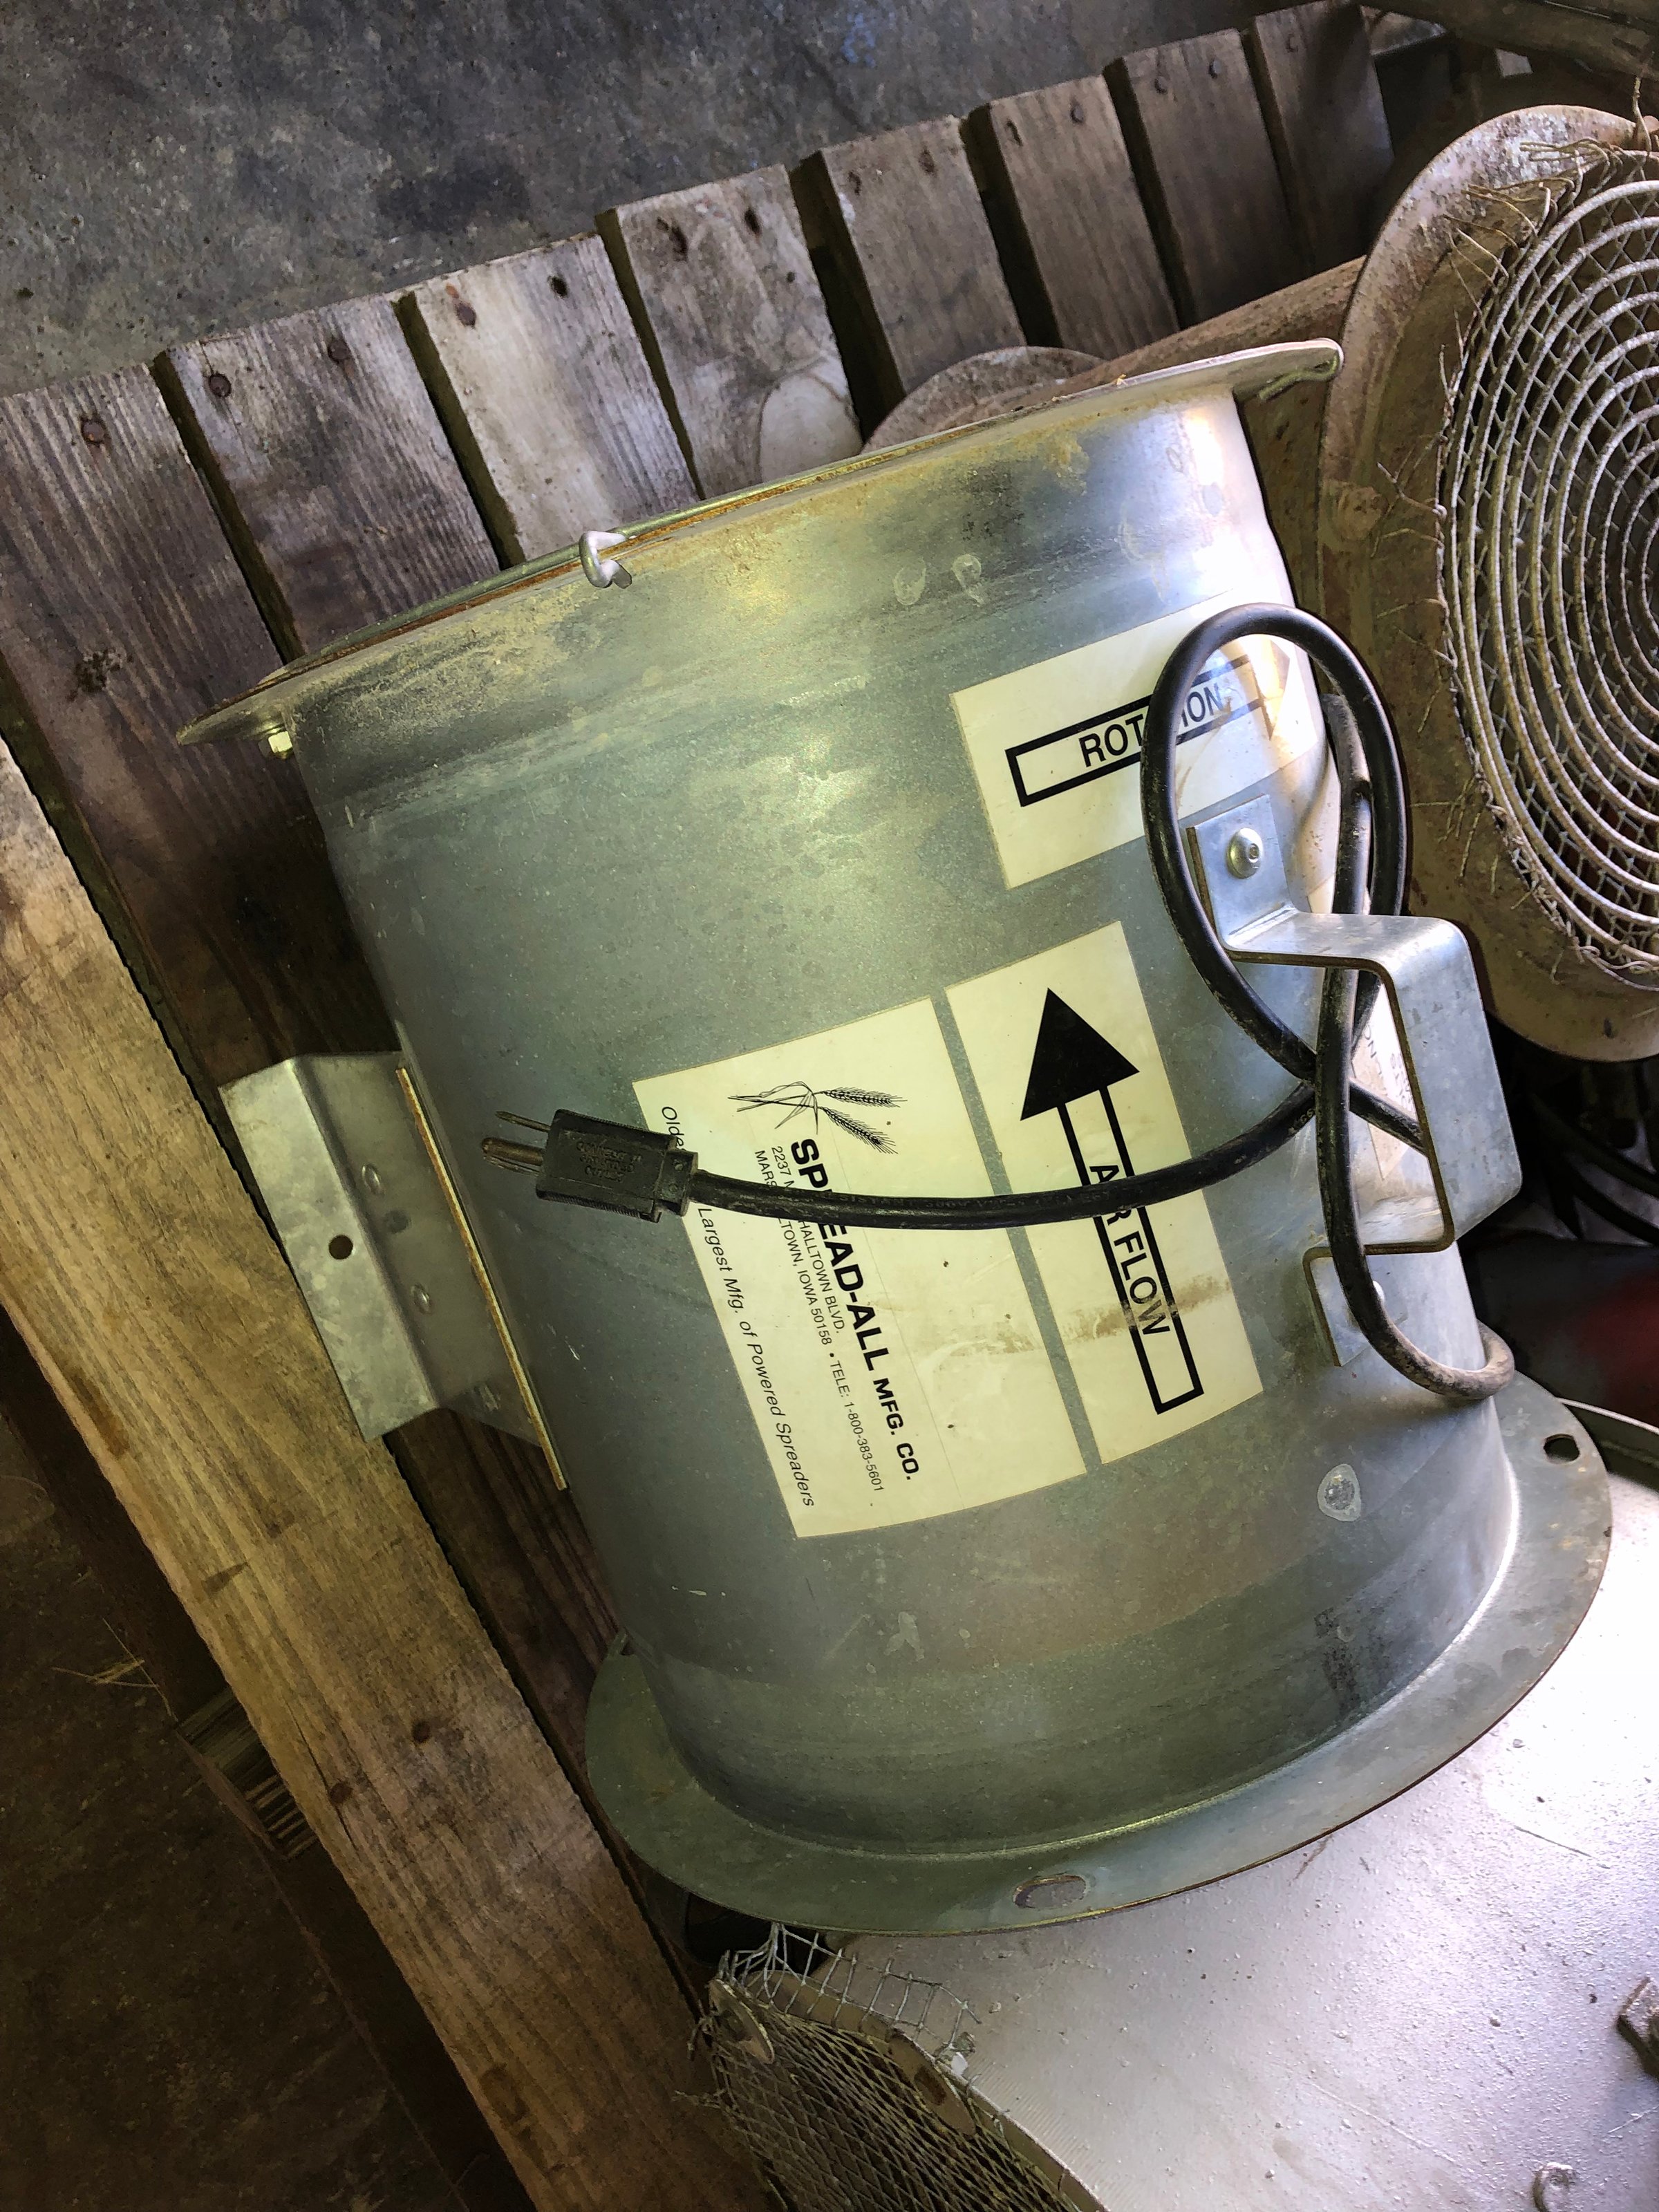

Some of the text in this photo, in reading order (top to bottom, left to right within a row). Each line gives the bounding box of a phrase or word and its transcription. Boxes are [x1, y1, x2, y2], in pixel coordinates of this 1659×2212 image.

[1078, 682, 1224, 768] ROTION
[662, 1107, 814, 1506] Olde Largest Mfg. of Powered Spreaders
[771, 1146, 792, 1176] 2237
[825, 1295, 845, 1333] BLVD.
[791, 1139, 919, 1481] SPEAD-ALL MFG. CO.
[1089, 1165, 1170, 1335] AR FLOW
[798, 1270, 818, 1306] IOWA
[810, 1308, 832, 1345] 50158
[830, 1360, 850, 1400] TELE:
[845, 1401, 884, 1491] 1-800-383-5601
